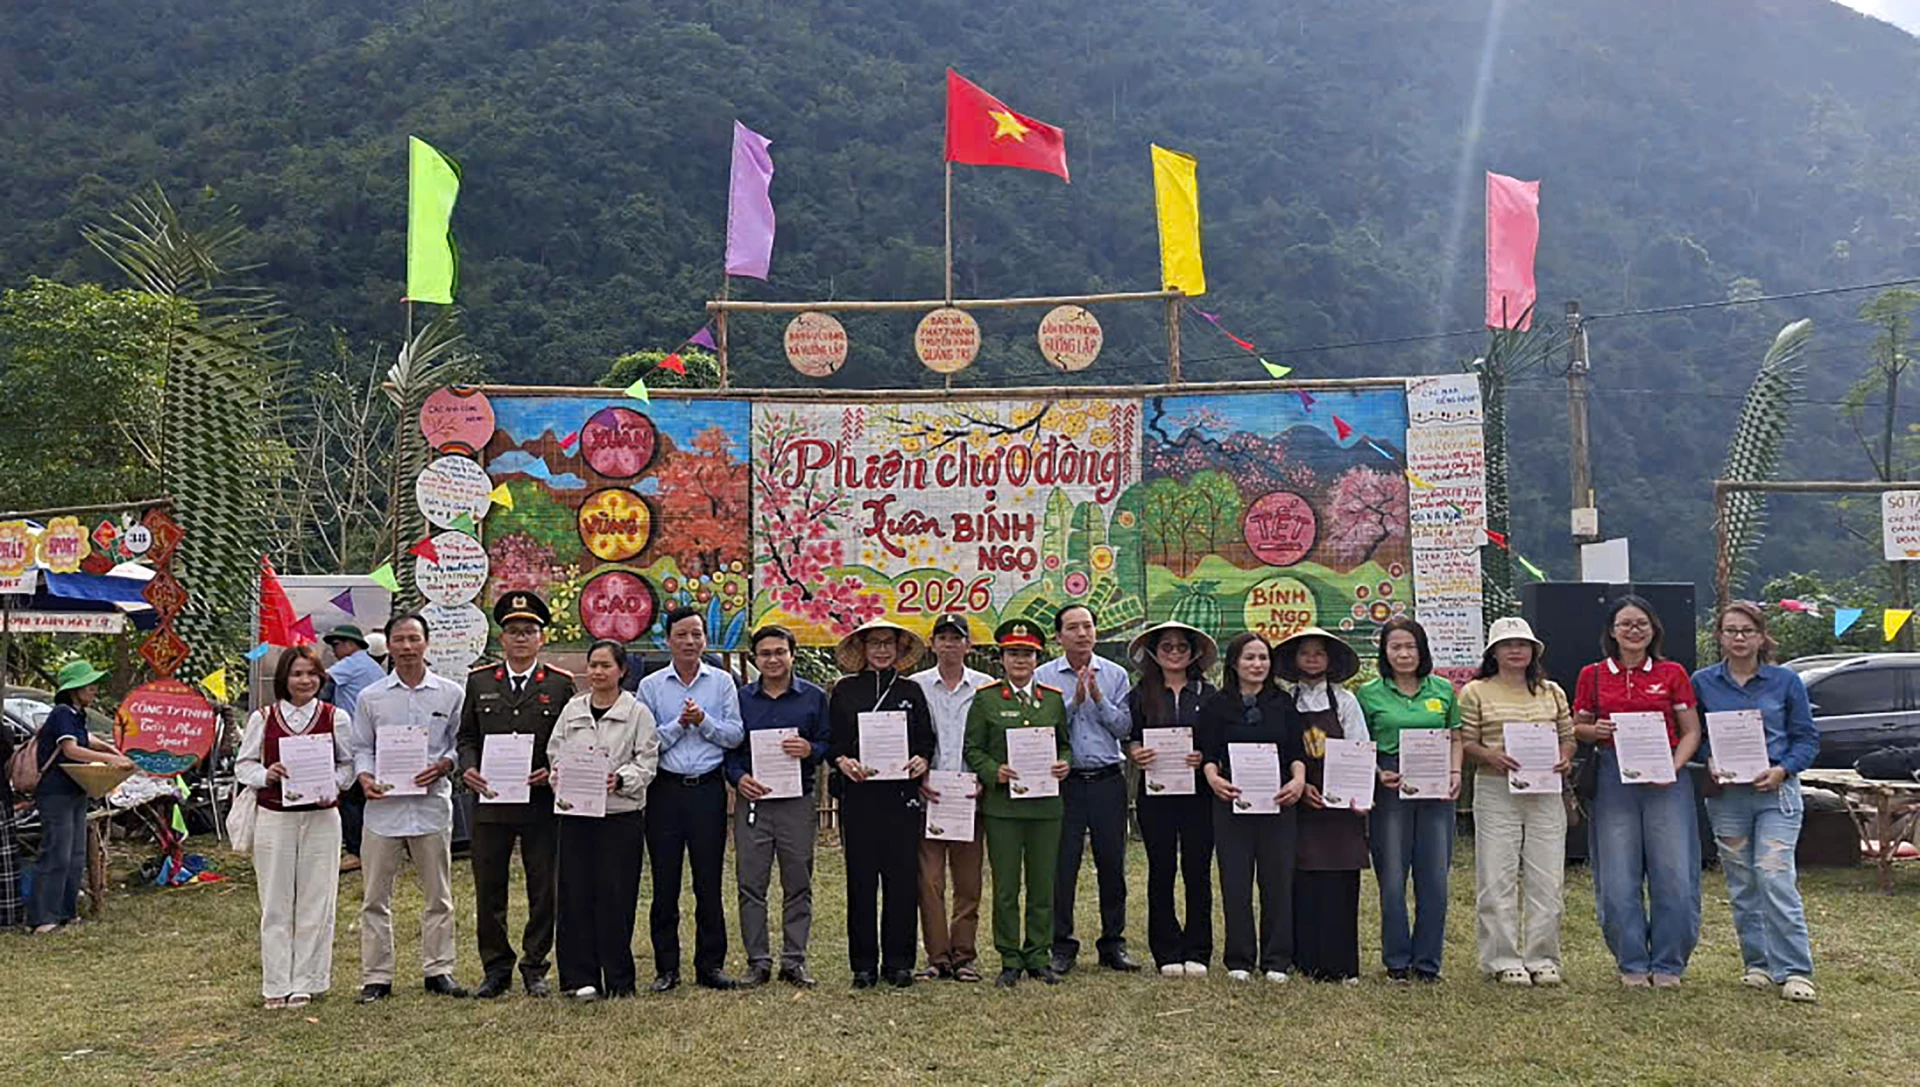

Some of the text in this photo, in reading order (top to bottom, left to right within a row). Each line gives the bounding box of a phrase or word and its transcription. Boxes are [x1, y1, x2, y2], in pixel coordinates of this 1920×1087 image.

[591, 421, 650, 450] XUÂN
[781, 437, 928, 490] Phiên
[935, 440, 1004, 501] chợ
[582, 510, 638, 536] VÙNG
[861, 494, 1035, 559] Xuân BÍNH
[1249, 500, 1311, 542] TẾT
[976, 546, 1038, 581] NGỌ
[592, 594, 641, 615] CAO
[896, 575, 996, 614] 2026
[1250, 582, 1306, 607] BÍNH
[1270, 608, 1311, 627] NGỌ
